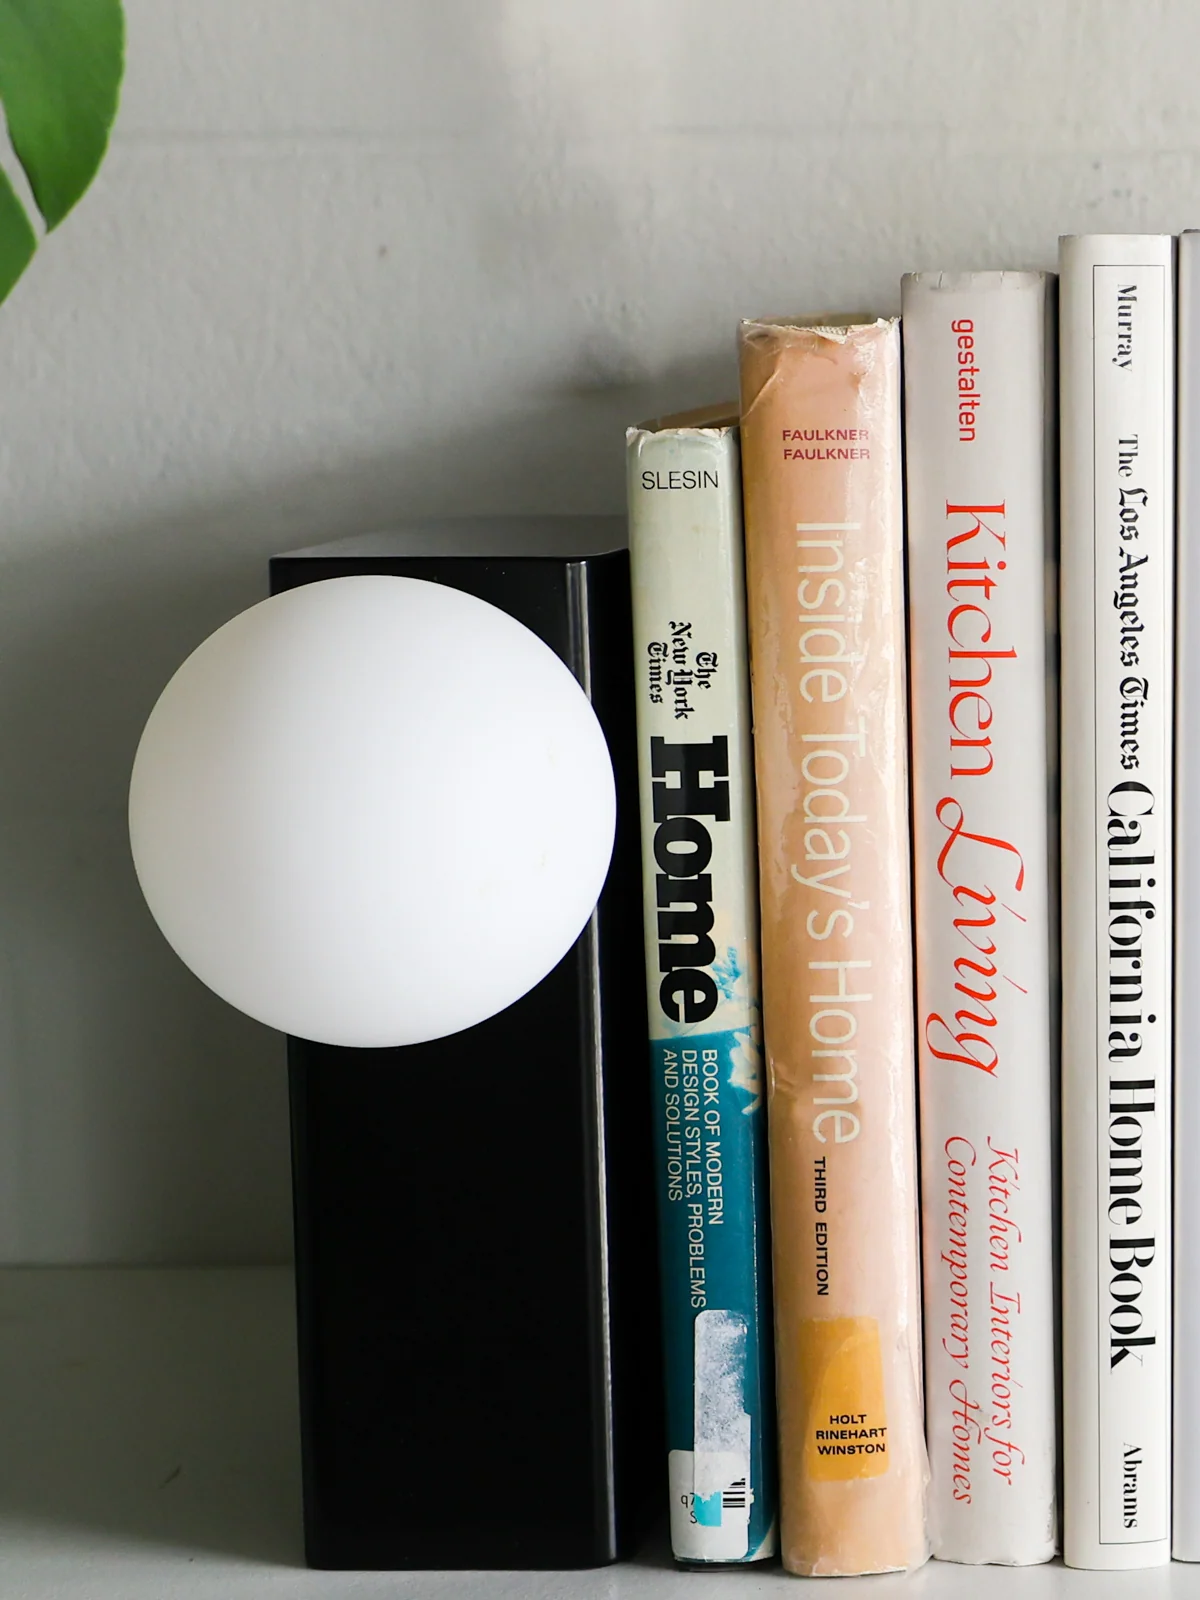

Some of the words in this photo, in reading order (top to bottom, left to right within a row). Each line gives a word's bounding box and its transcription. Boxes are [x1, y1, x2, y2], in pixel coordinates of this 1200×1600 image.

[1111, 283, 1139, 373] Murray
[951, 318, 980, 442] gestalten
[782, 429, 868, 441] FAULKNER
[783, 448, 870, 460] FAULKNER
[1117, 434, 1139, 477] The
[642, 470, 719, 490] SLESIN
[1118, 487, 1149, 541] Los
[668, 621, 692, 665] New
[795, 521, 860, 703] Inside
[946, 499, 1018, 780] Kitchen
[1112, 547, 1148, 666] Angeles
[648, 642, 669, 703] Times
[665, 669, 695, 719] York
[696, 652, 718, 689] The
[1118, 675, 1149, 770] Times
[791, 725, 870, 941] Today's
[651, 734, 730, 1024] Home
[1106, 780, 1157, 1063] California
[925, 796, 1028, 1078] Living
[663, 1049, 679, 1089] AND
[682, 1049, 700, 1122] DESIGN
[702, 1049, 719, 1104] BOOK
[808, 960, 872, 1144] Home
[665, 1092, 682, 1201] SOLUTIONS
[684, 1127, 702, 1198] STYLES,
[704, 1107, 721, 1136] OF
[1107, 1076, 1155, 1225] Home
[706, 1140, 724, 1226] MODERN
[814, 1156, 827, 1214] THIRD
[986, 1136, 1022, 1271] Kitchen
[687, 1204, 706, 1308] PROBLEMS
[815, 1221, 829, 1296] EDITION
[940, 1136, 977, 1375] Contemporary
[1107, 1235, 1157, 1369] Book
[988, 1281, 1022, 1428] Interiors
[815, 1427, 887, 1441] RINEHART
[818, 1443, 885, 1455] WINSTON
[829, 1414, 867, 1425] HOLT
[948, 1380, 982, 1504] Homes
[984, 1423, 1025, 1485] for
[1123, 1442, 1142, 1529] Abrams
